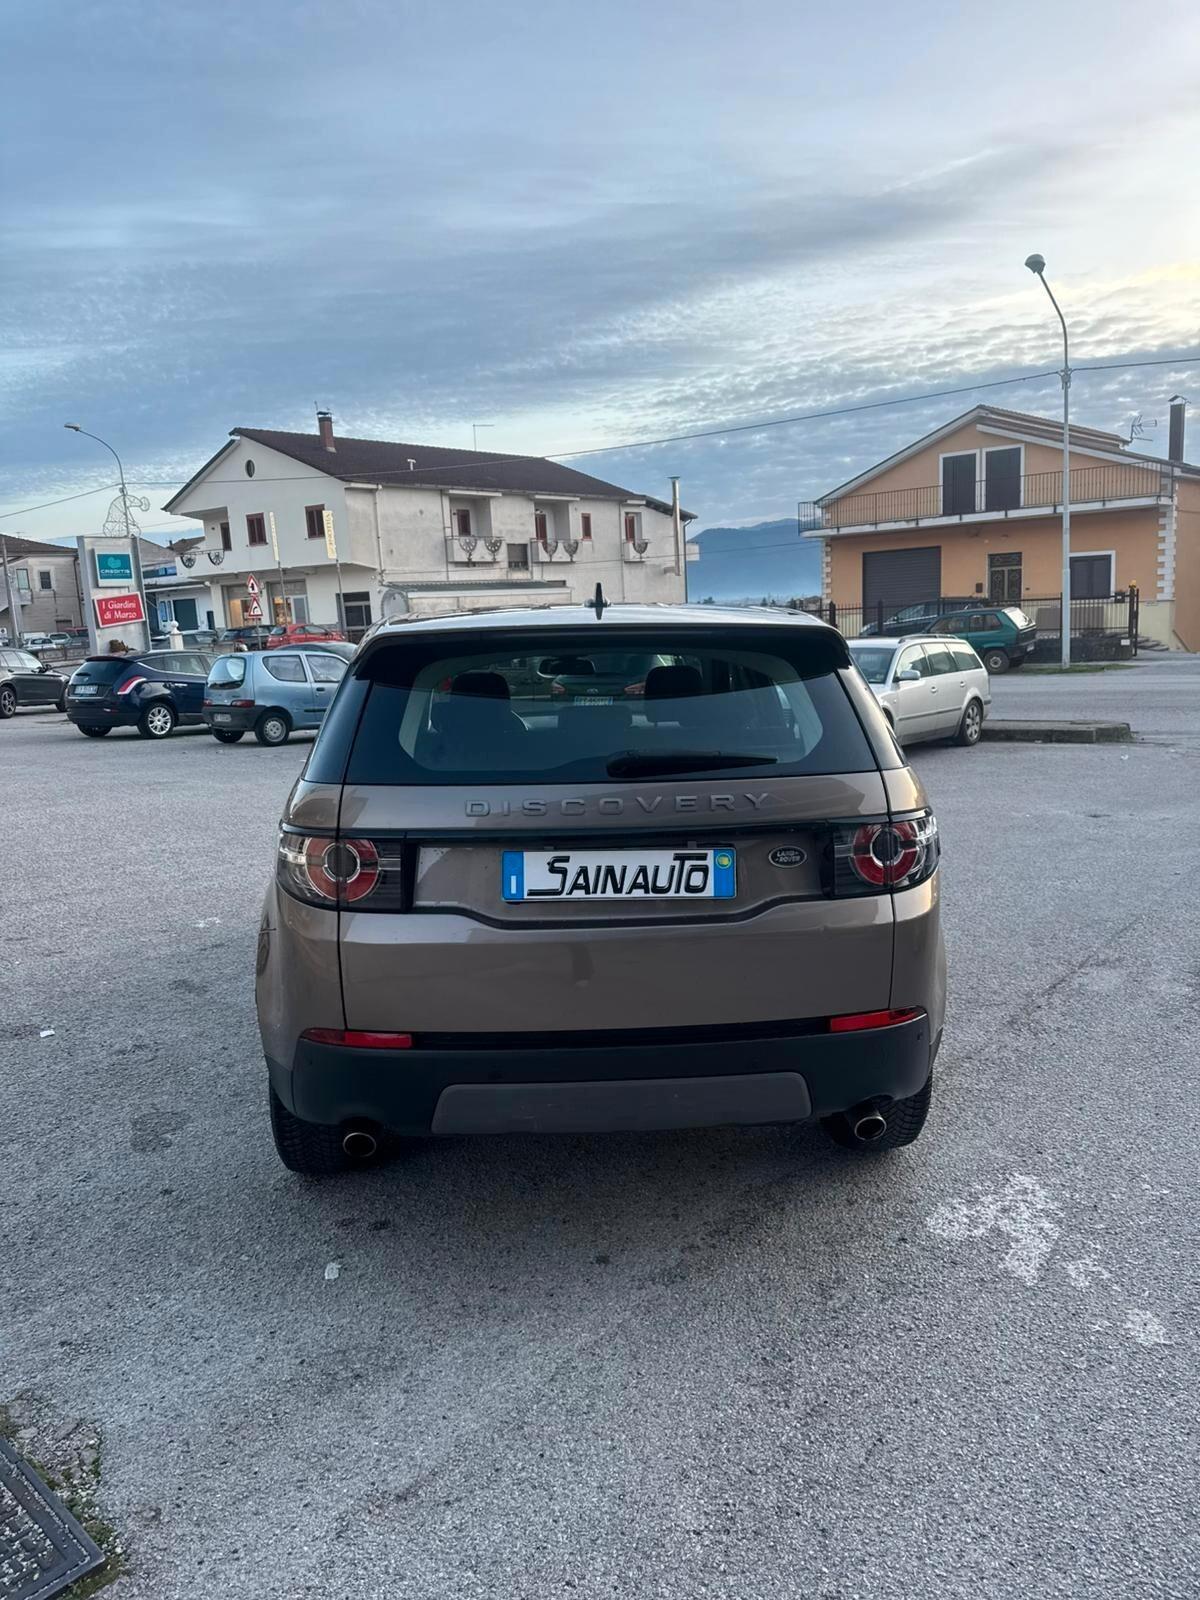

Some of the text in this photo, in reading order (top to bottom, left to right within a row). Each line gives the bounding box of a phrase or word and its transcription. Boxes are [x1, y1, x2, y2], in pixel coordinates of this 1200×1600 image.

[102, 600, 136, 610] I Giardini
[104, 610, 137, 619] di Marzo
[465, 793, 769, 817] DISCOVERY
[527, 853, 710, 897] SAINAUTO
